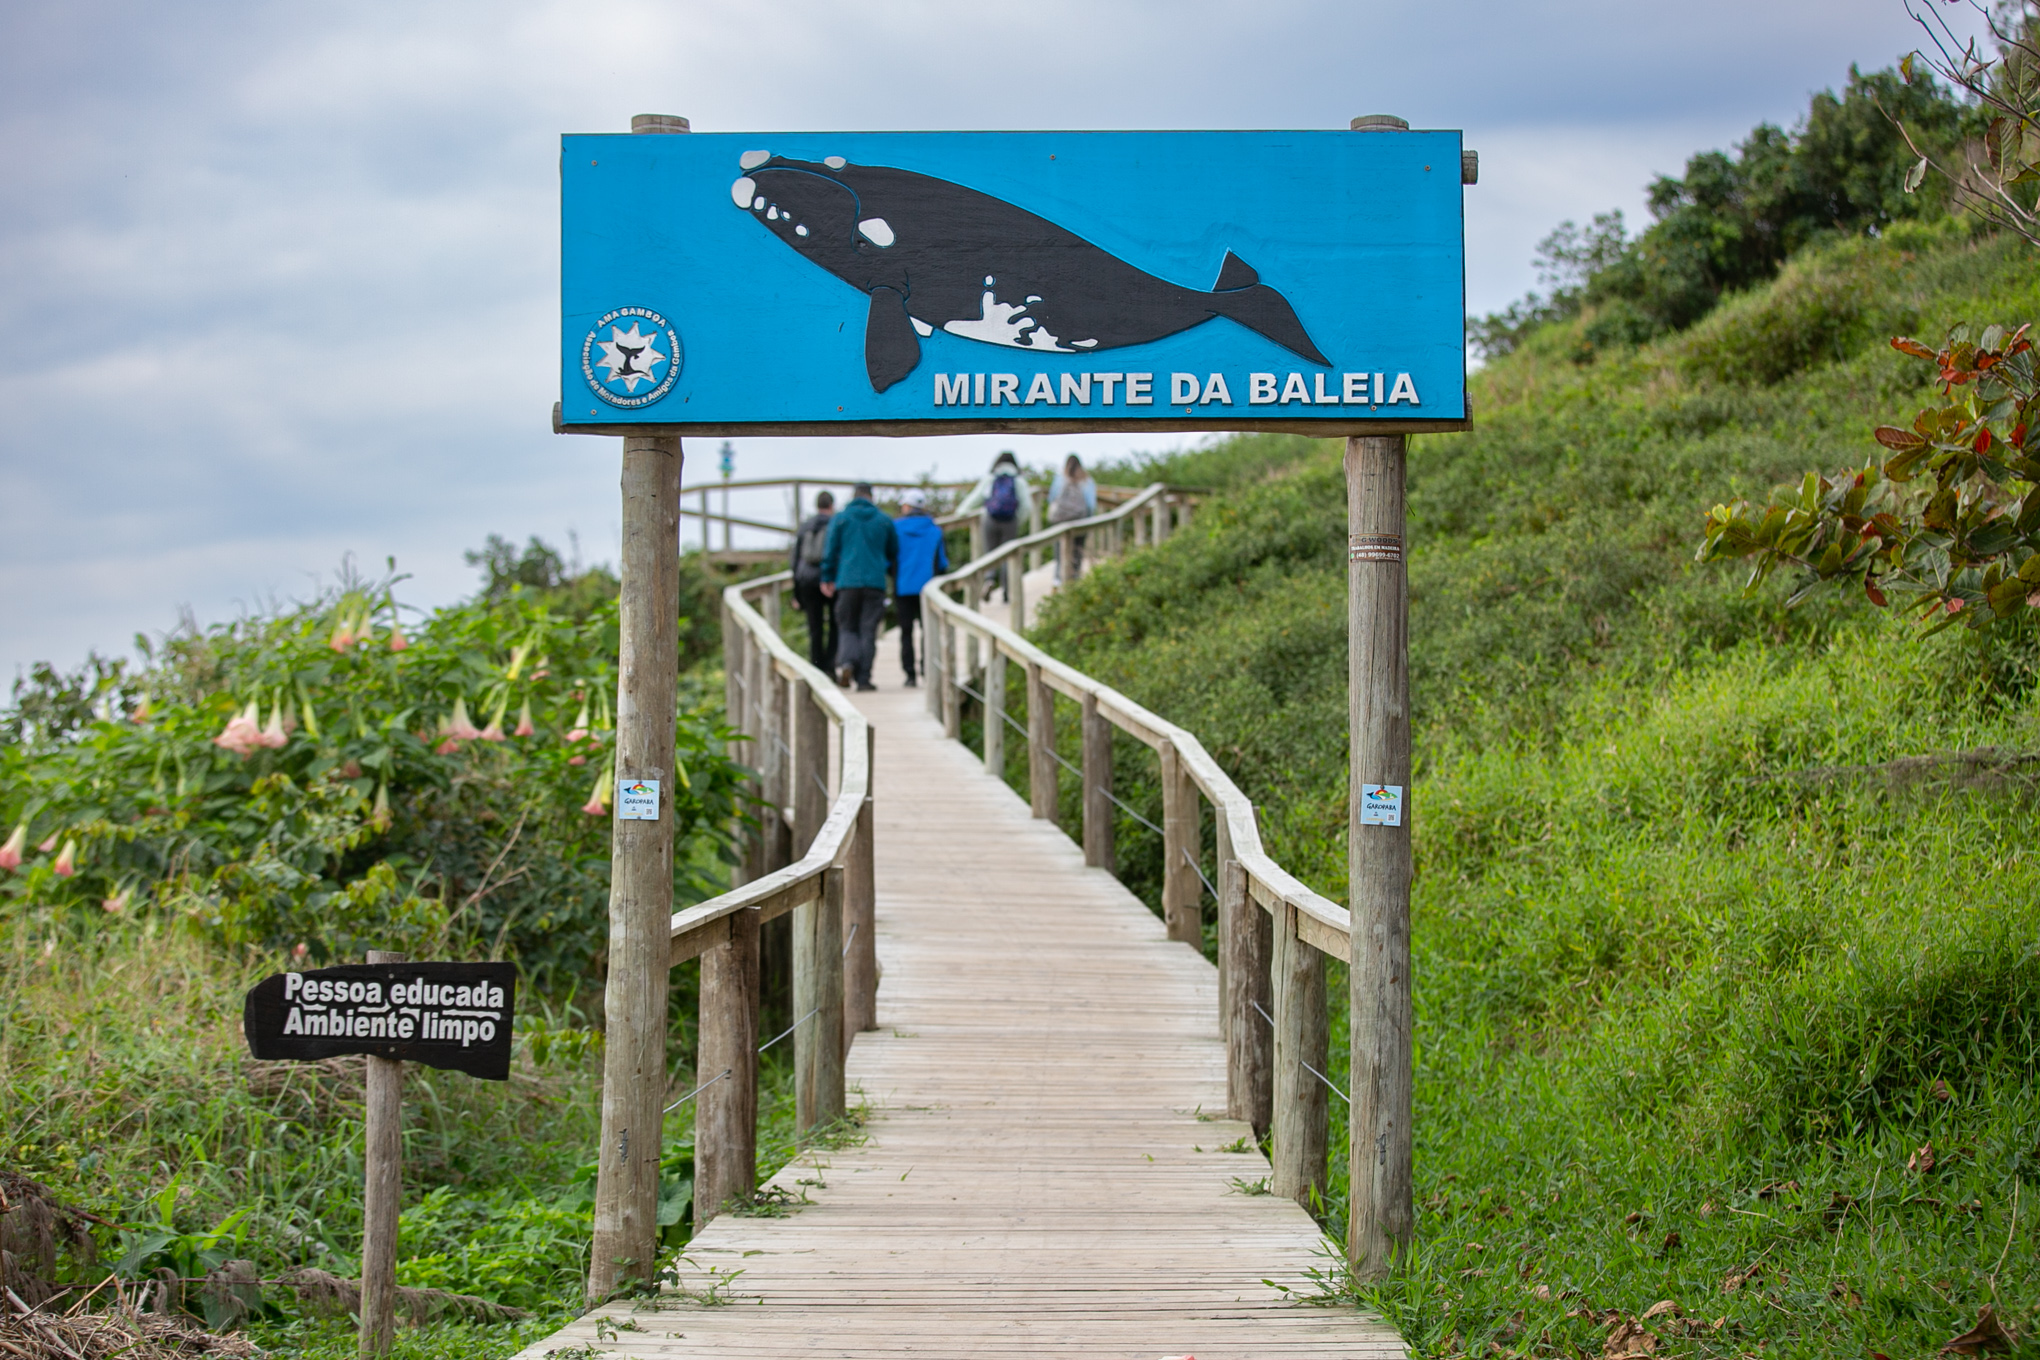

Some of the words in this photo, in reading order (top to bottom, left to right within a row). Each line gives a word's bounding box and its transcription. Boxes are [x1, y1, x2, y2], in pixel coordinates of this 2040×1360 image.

[597, 311, 620, 328] AMA
[621, 308, 666, 328] GAMBOA
[648, 376, 674, 400] Amigos
[934, 372, 1153, 406] MIRANTE
[1170, 372, 1234, 406] DA
[1248, 372, 1421, 406] BALEIA
[284, 972, 382, 1004] Pessoa
[390, 977, 505, 1009] educada
[282, 1006, 415, 1039] Ambiente
[421, 1011, 496, 1047] limpo
